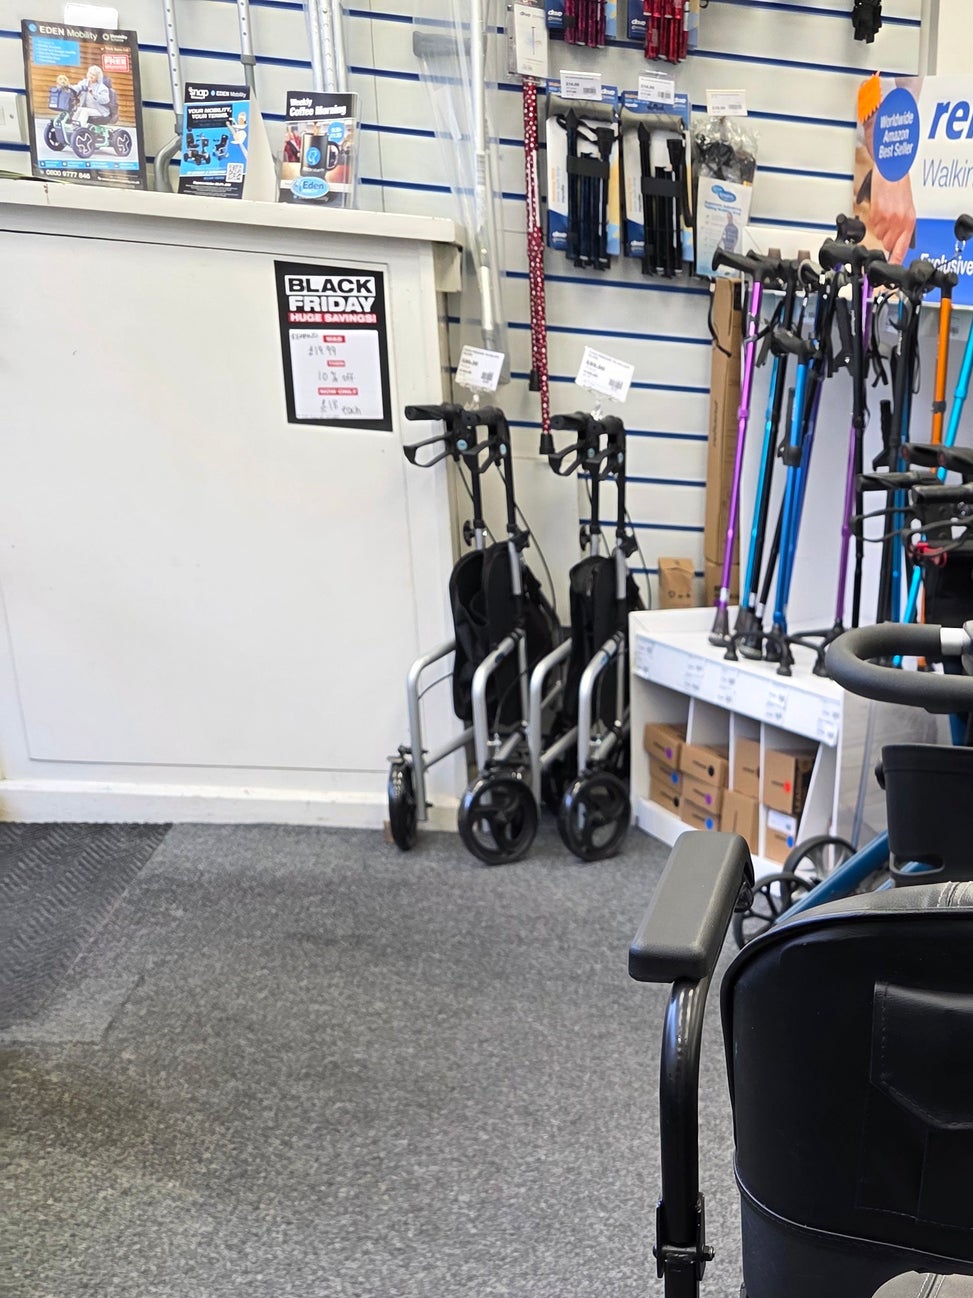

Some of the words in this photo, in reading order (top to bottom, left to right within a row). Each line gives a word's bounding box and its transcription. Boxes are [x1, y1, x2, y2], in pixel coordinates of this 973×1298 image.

[40, 26, 65, 36] EDEN
[67, 29, 98, 40] Mobility
[289, 97, 313, 107] Weekly
[289, 107, 314, 116] Coffee
[315, 104, 347, 116] Morning
[880, 110, 914, 129] Worldwide
[883, 128, 909, 143] Amazon
[879, 144, 894, 159] Best
[894, 142, 914, 157] Seller
[62, 170, 77, 178] 9777
[302, 180, 325, 190] Eden
[288, 278, 373, 293] BLACK
[289, 296, 375, 312] FRIDAY
[289, 312, 323, 322] HUGE
[323, 313, 378, 323] SAVINGS!
